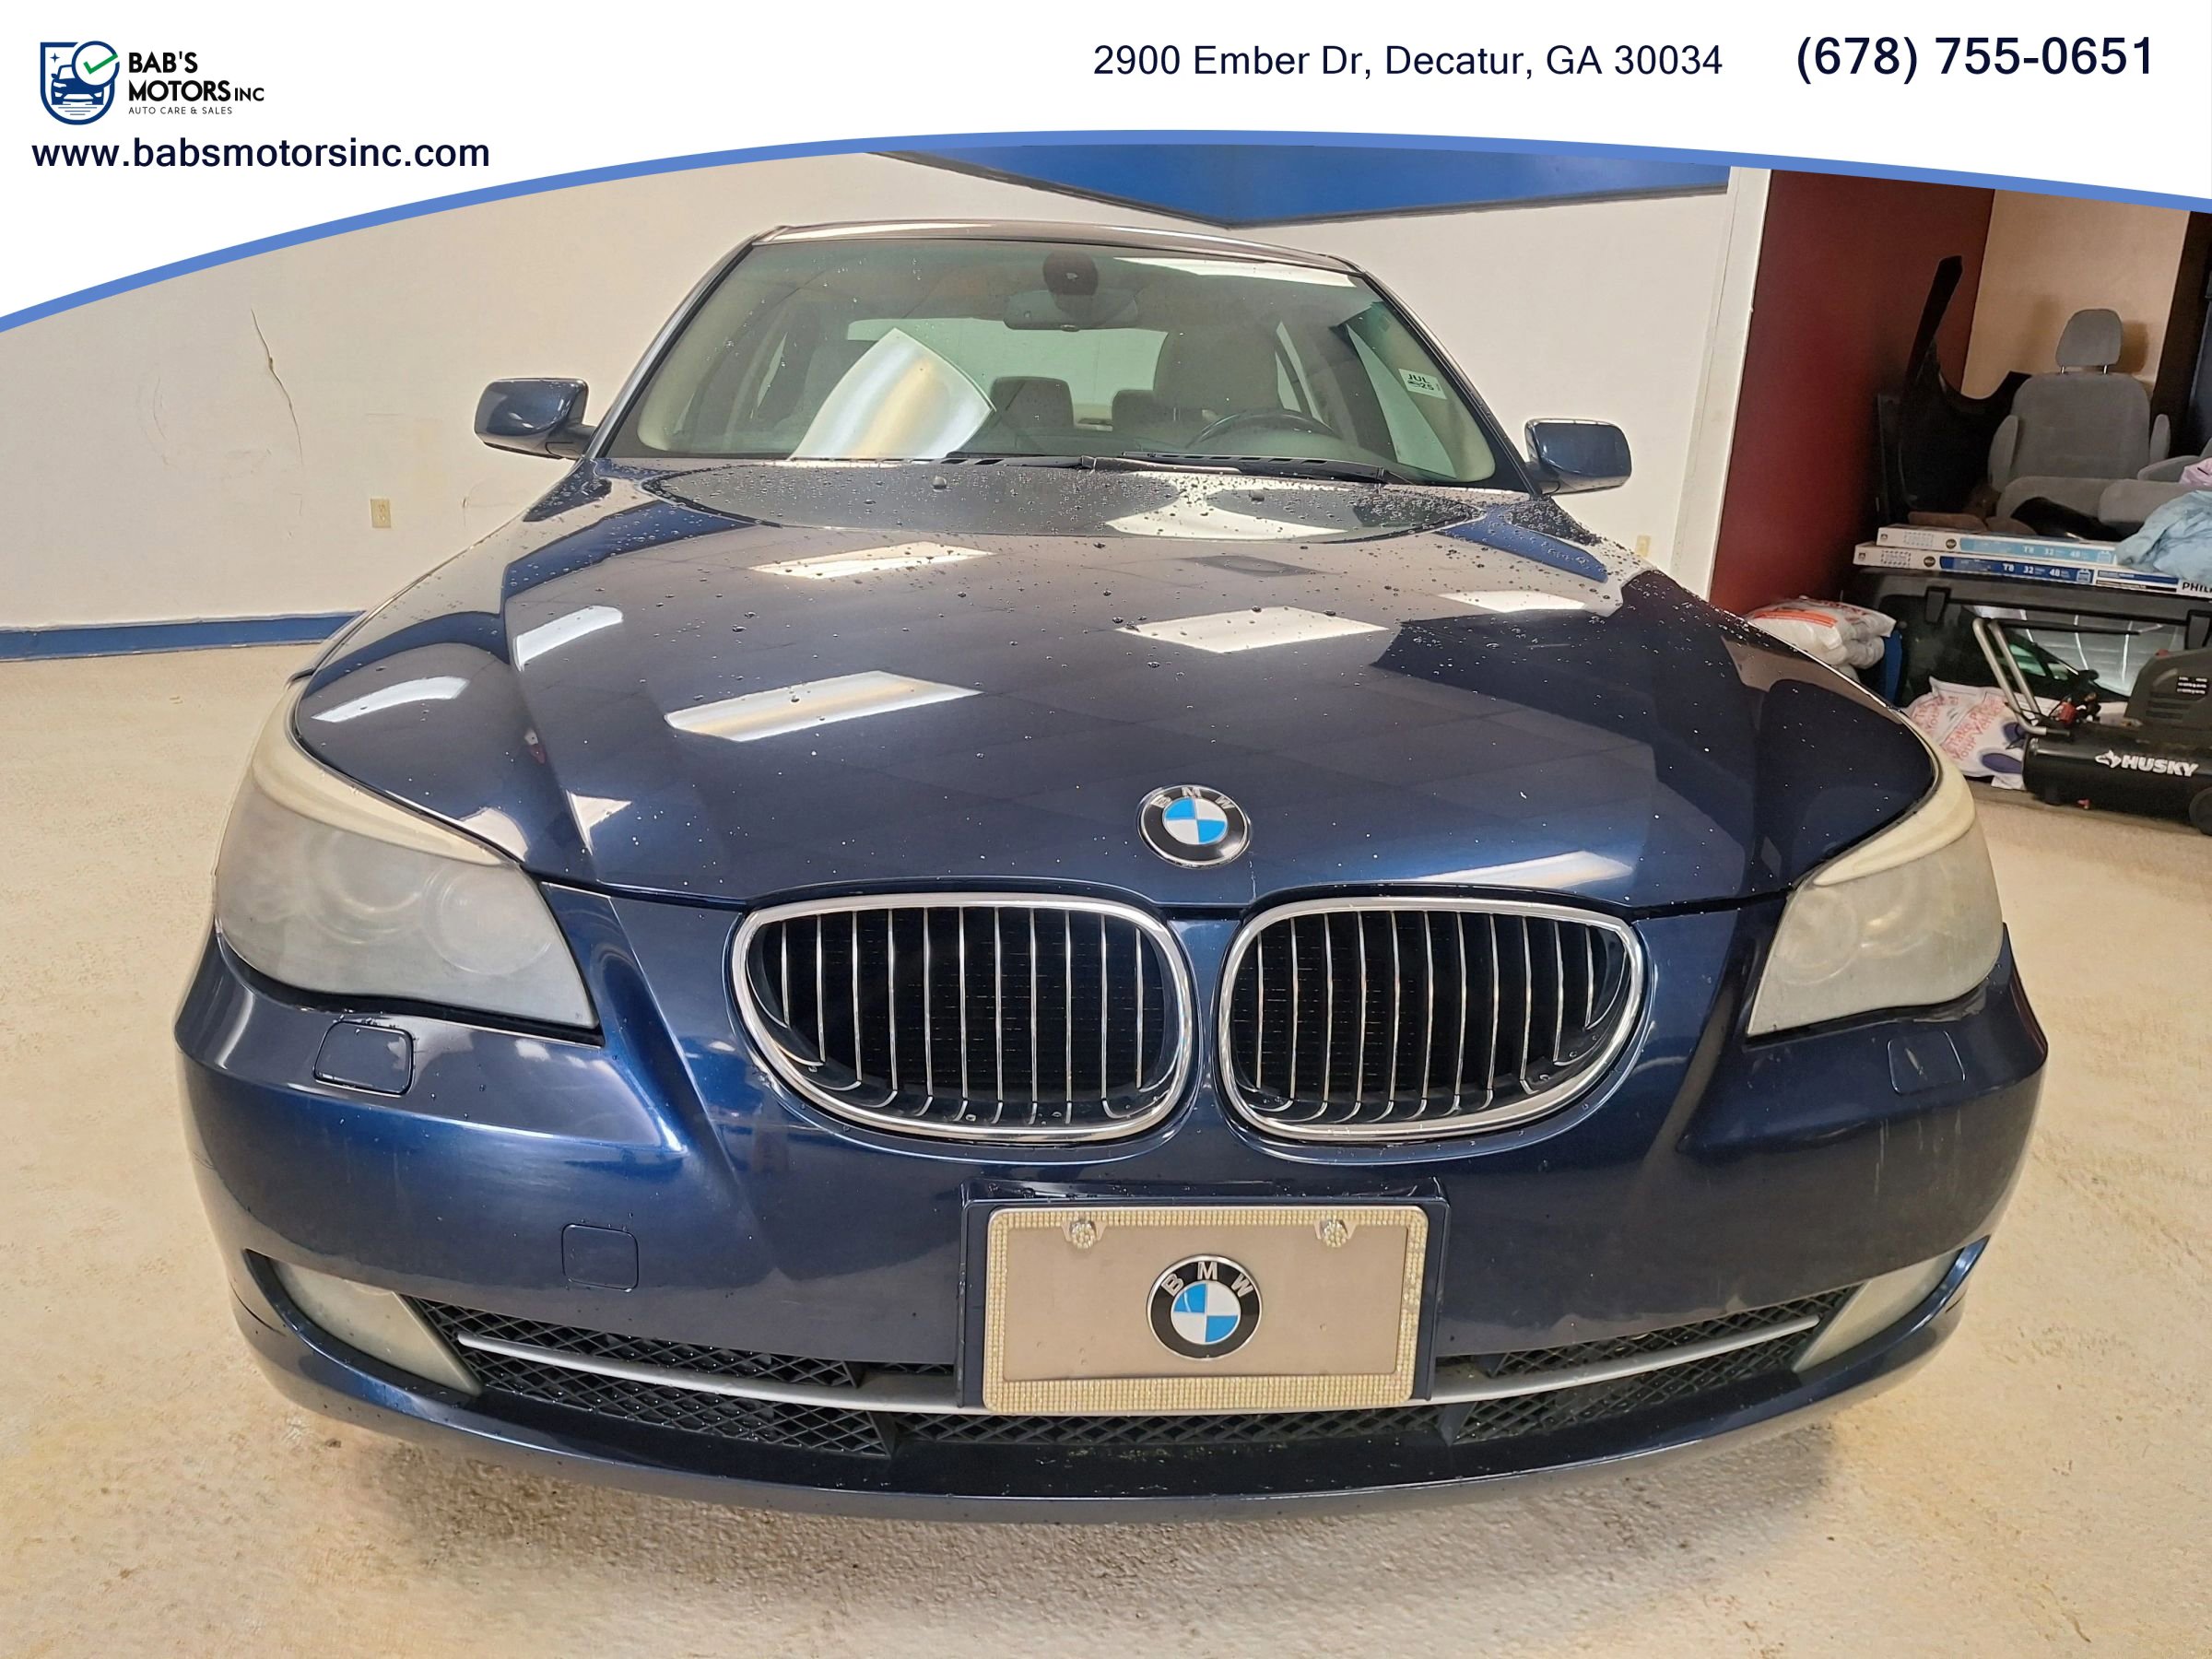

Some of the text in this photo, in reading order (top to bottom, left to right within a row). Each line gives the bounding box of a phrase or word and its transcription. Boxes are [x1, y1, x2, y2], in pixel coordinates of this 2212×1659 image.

[1407, 373, 1430, 384] JUL
[2003, 563, 2015, 572] T8
[2023, 565, 2034, 574] 32
[2049, 569, 2061, 577] 48
[2121, 755, 2199, 777] HUSKY
[1150, 786, 1236, 809] BMW
[1160, 1261, 1254, 1298] BMW
